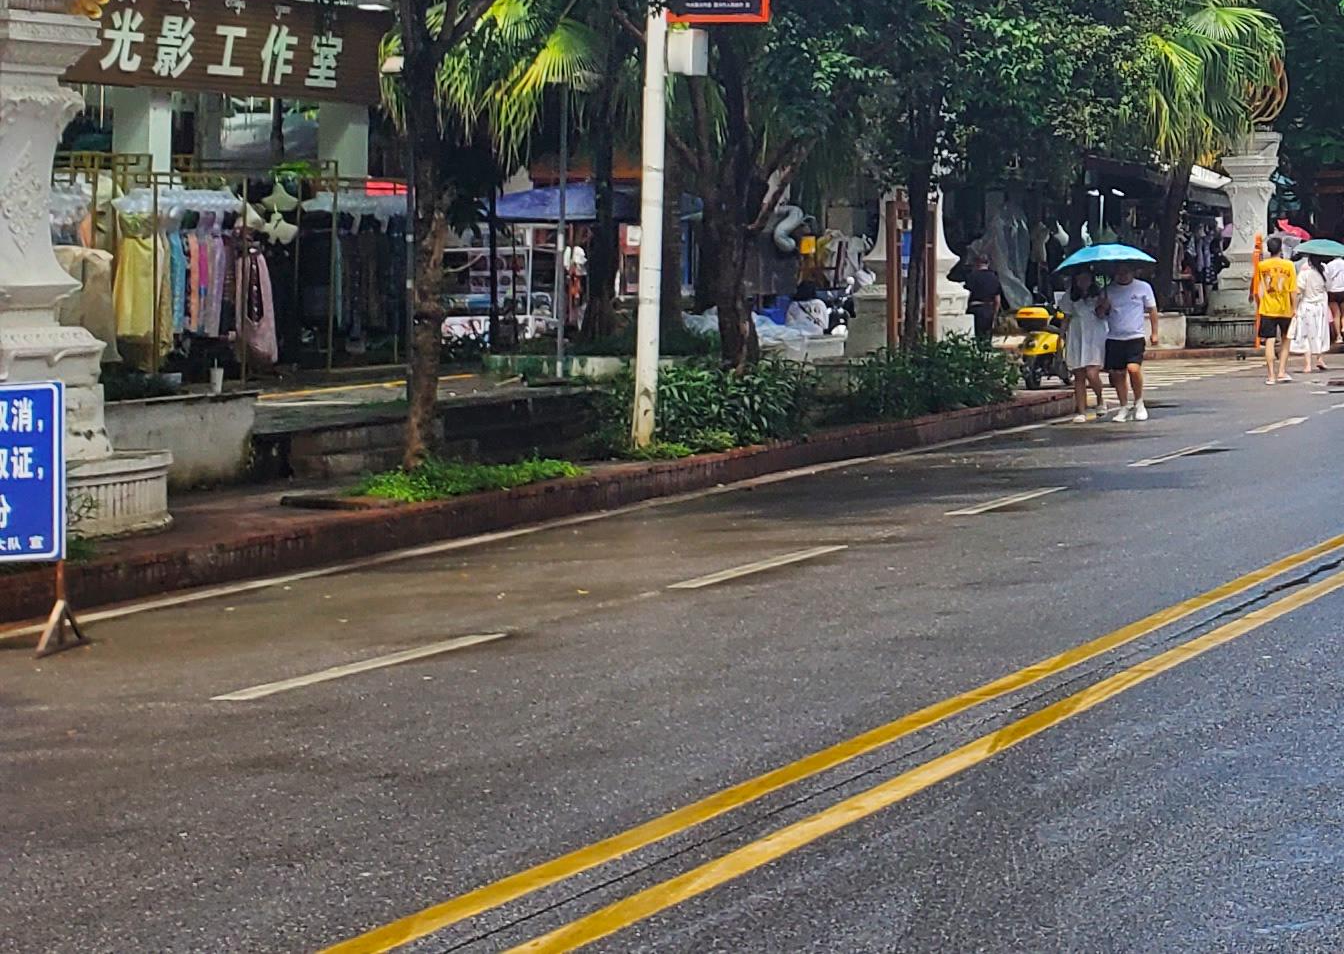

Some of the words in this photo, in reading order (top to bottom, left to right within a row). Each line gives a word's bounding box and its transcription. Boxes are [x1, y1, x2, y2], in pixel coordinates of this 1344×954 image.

[99, 7, 344, 89] 光影工作室
[28, 535, 44, 550] 宣
